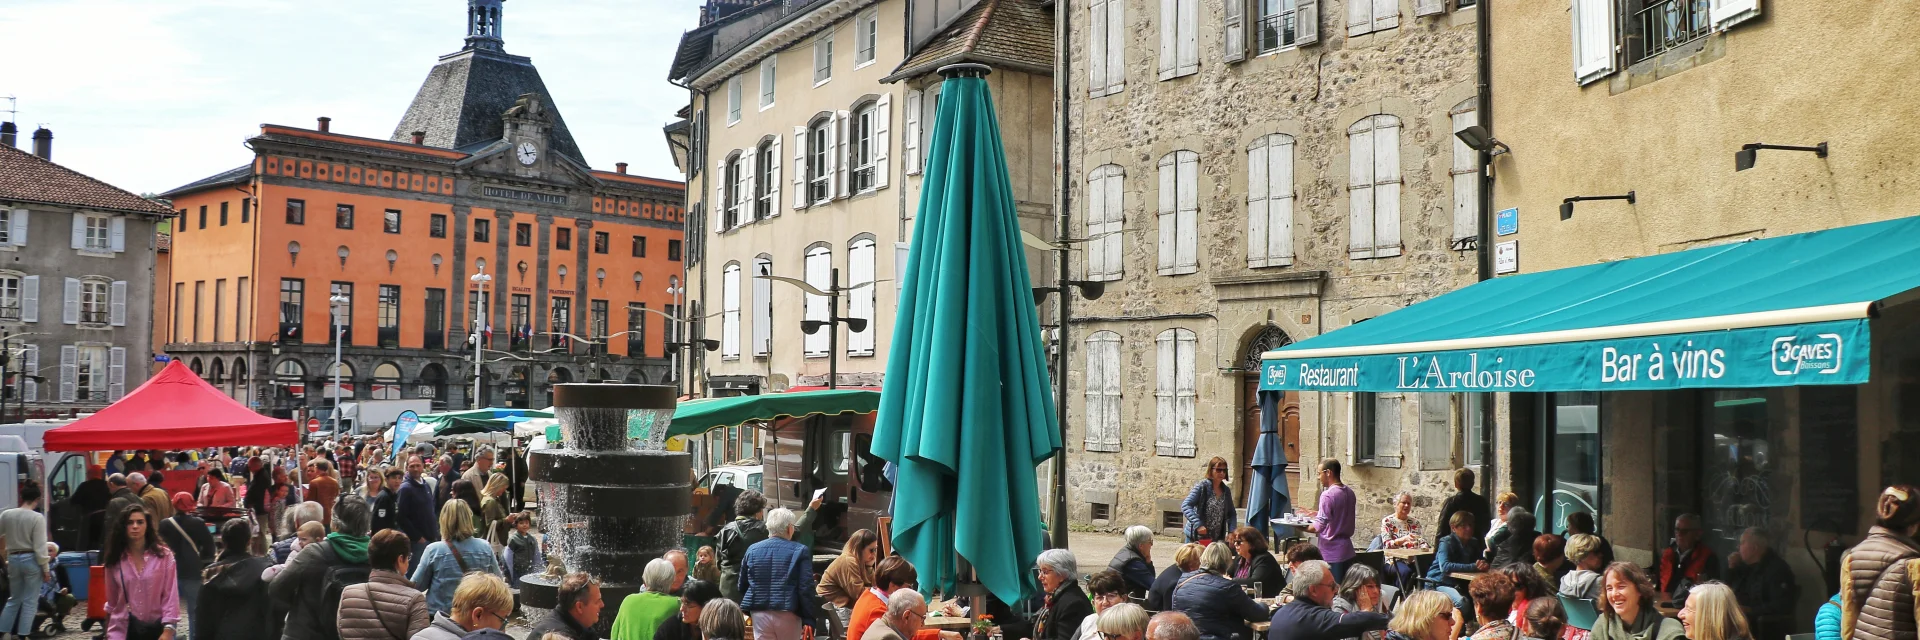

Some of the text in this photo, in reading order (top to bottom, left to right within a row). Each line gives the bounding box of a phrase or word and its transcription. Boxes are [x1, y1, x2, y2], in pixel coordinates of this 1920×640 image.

[485, 187, 565, 204] HOTEL DE VILLE
[1396, 353, 1535, 389] L'Ardoise
[1602, 340, 1725, 382] Bar à vins
[1800, 360, 1830, 369] Boissons
[1299, 362, 1358, 387] Restaurant
